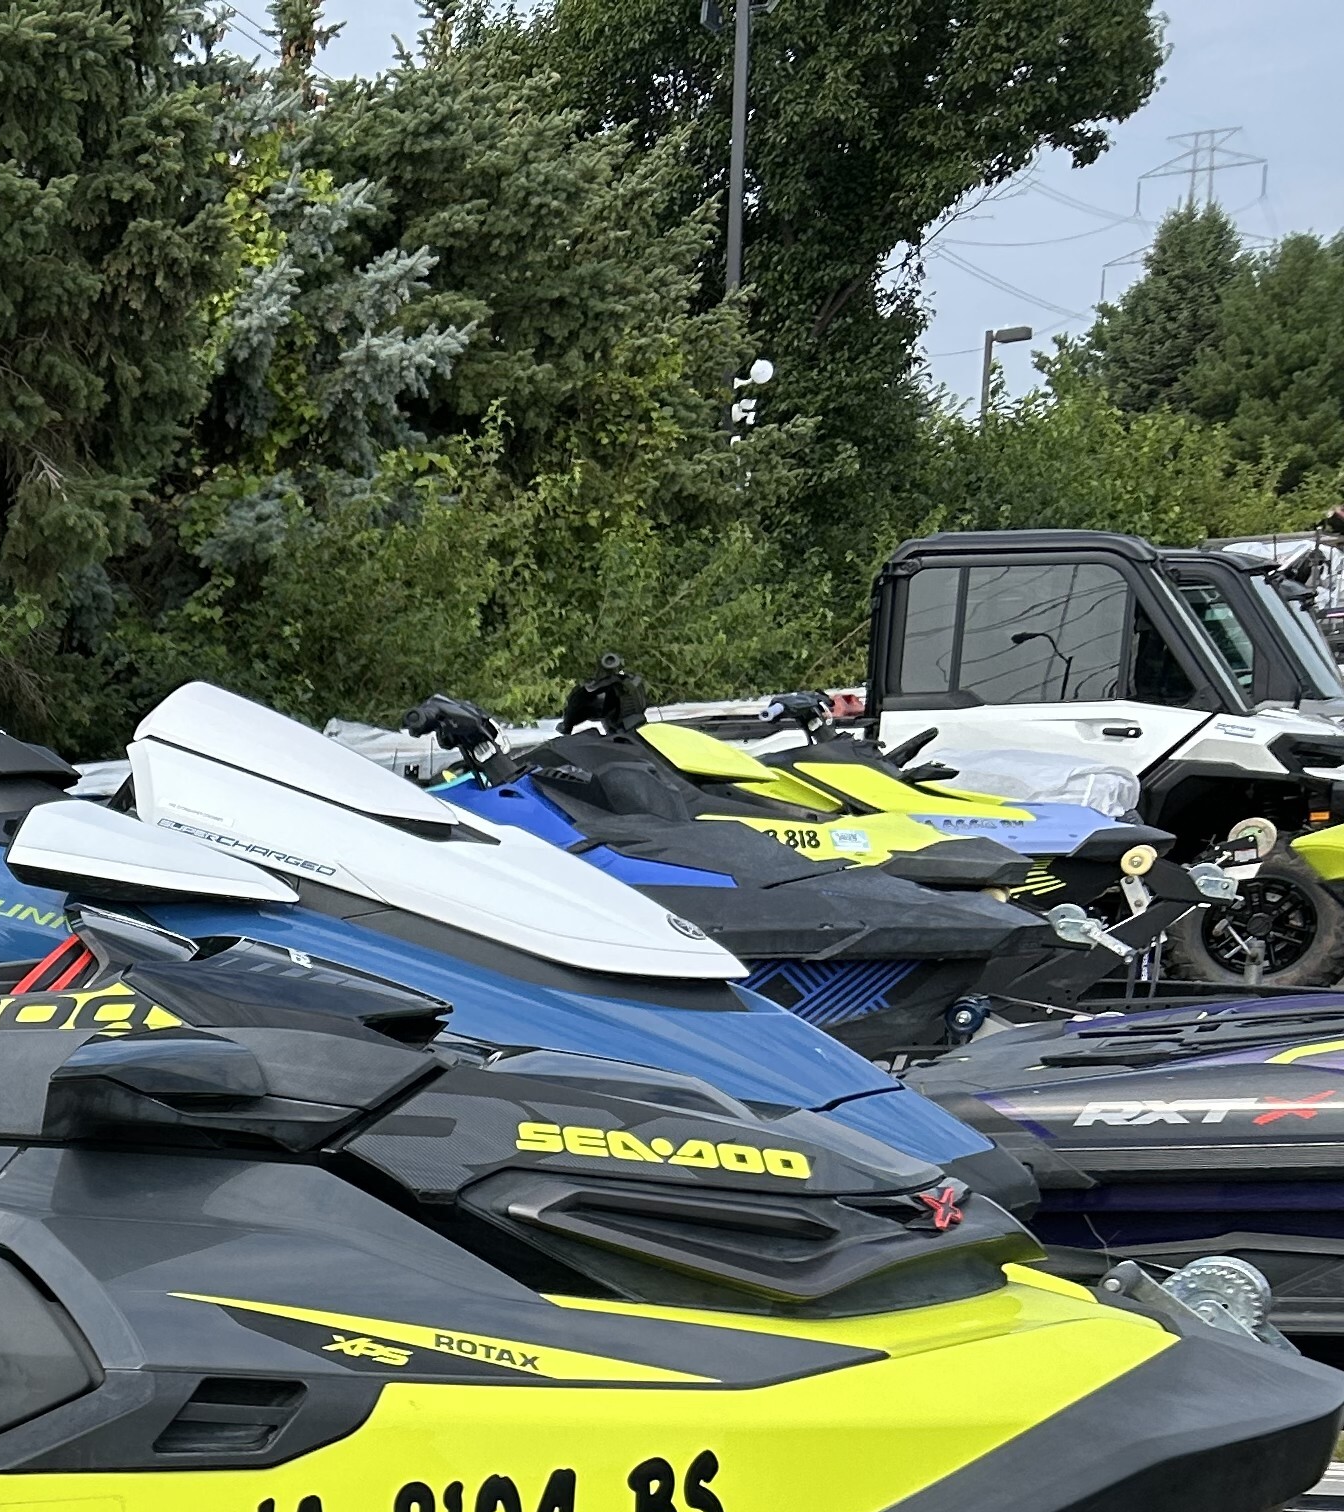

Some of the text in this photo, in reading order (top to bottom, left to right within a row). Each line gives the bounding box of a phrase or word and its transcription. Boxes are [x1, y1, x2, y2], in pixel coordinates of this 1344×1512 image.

[157, 818, 337, 877] SUPERCHARGED
[1072, 1097, 1259, 1127] RXT
[321, 1333, 540, 1371] XPS ROTAX
